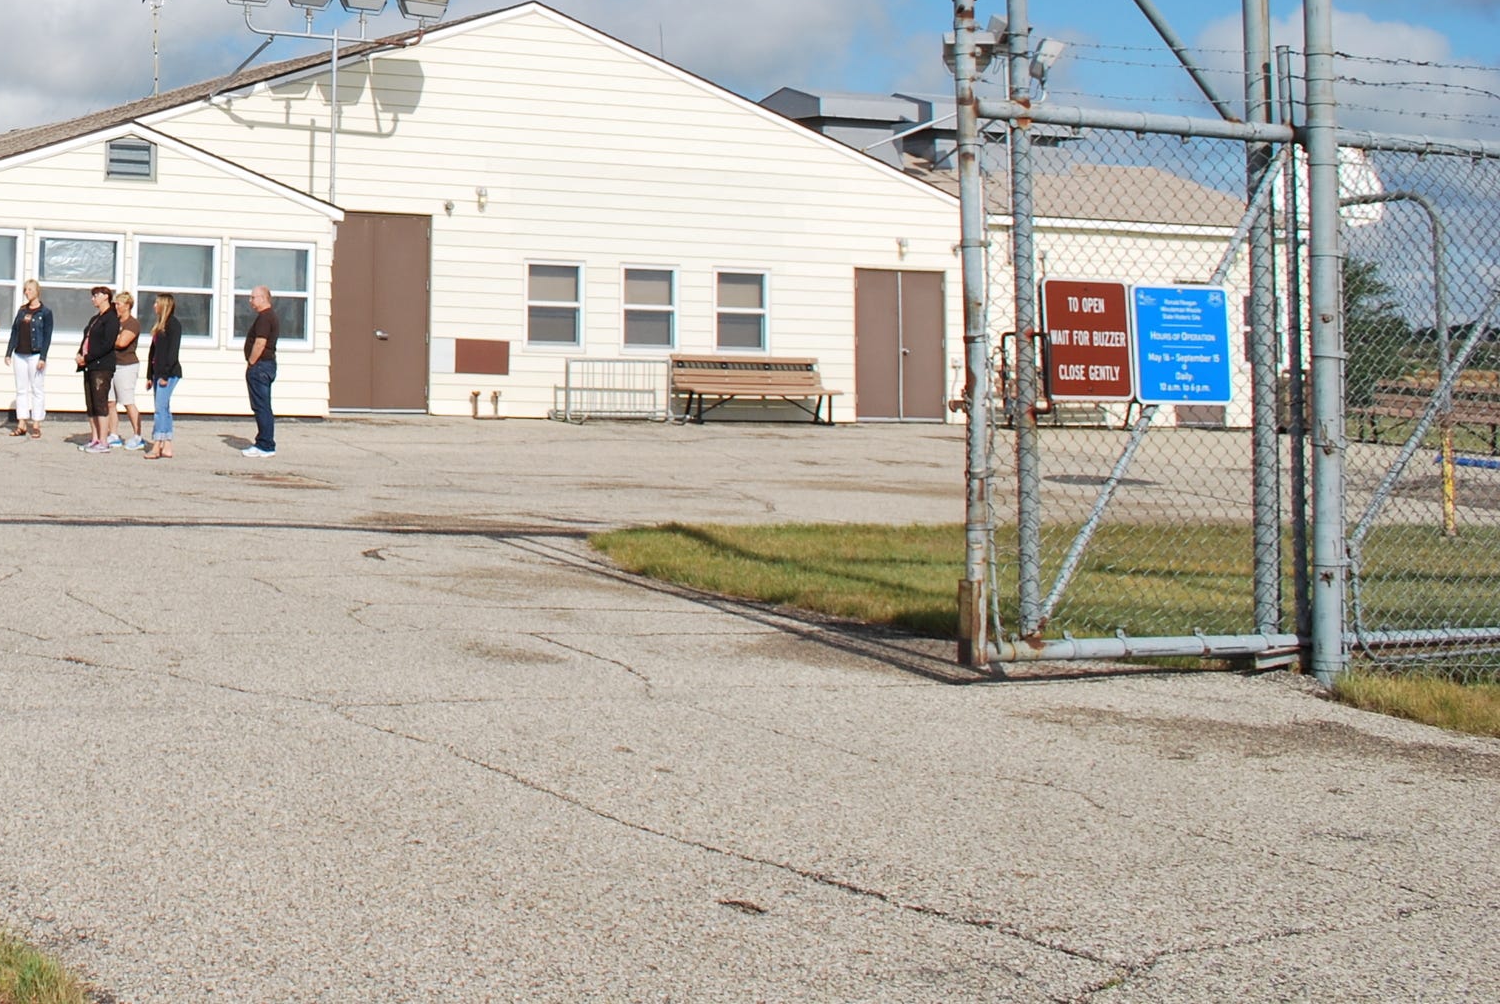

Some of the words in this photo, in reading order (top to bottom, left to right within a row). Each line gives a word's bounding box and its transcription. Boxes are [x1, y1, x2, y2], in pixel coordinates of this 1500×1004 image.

[1067, 296, 1079, 313] TO
[1082, 297, 1105, 313] OPEN
[1050, 329, 1070, 346] WAIT
[1073, 330, 1090, 346] FOR
[1092, 330, 1126, 347] BUZZER
[1148, 353, 1162, 363] May
[1175, 353, 1211, 363] September
[1058, 364, 1086, 380] CLOSE
[1088, 365, 1120, 381] GENTLY
